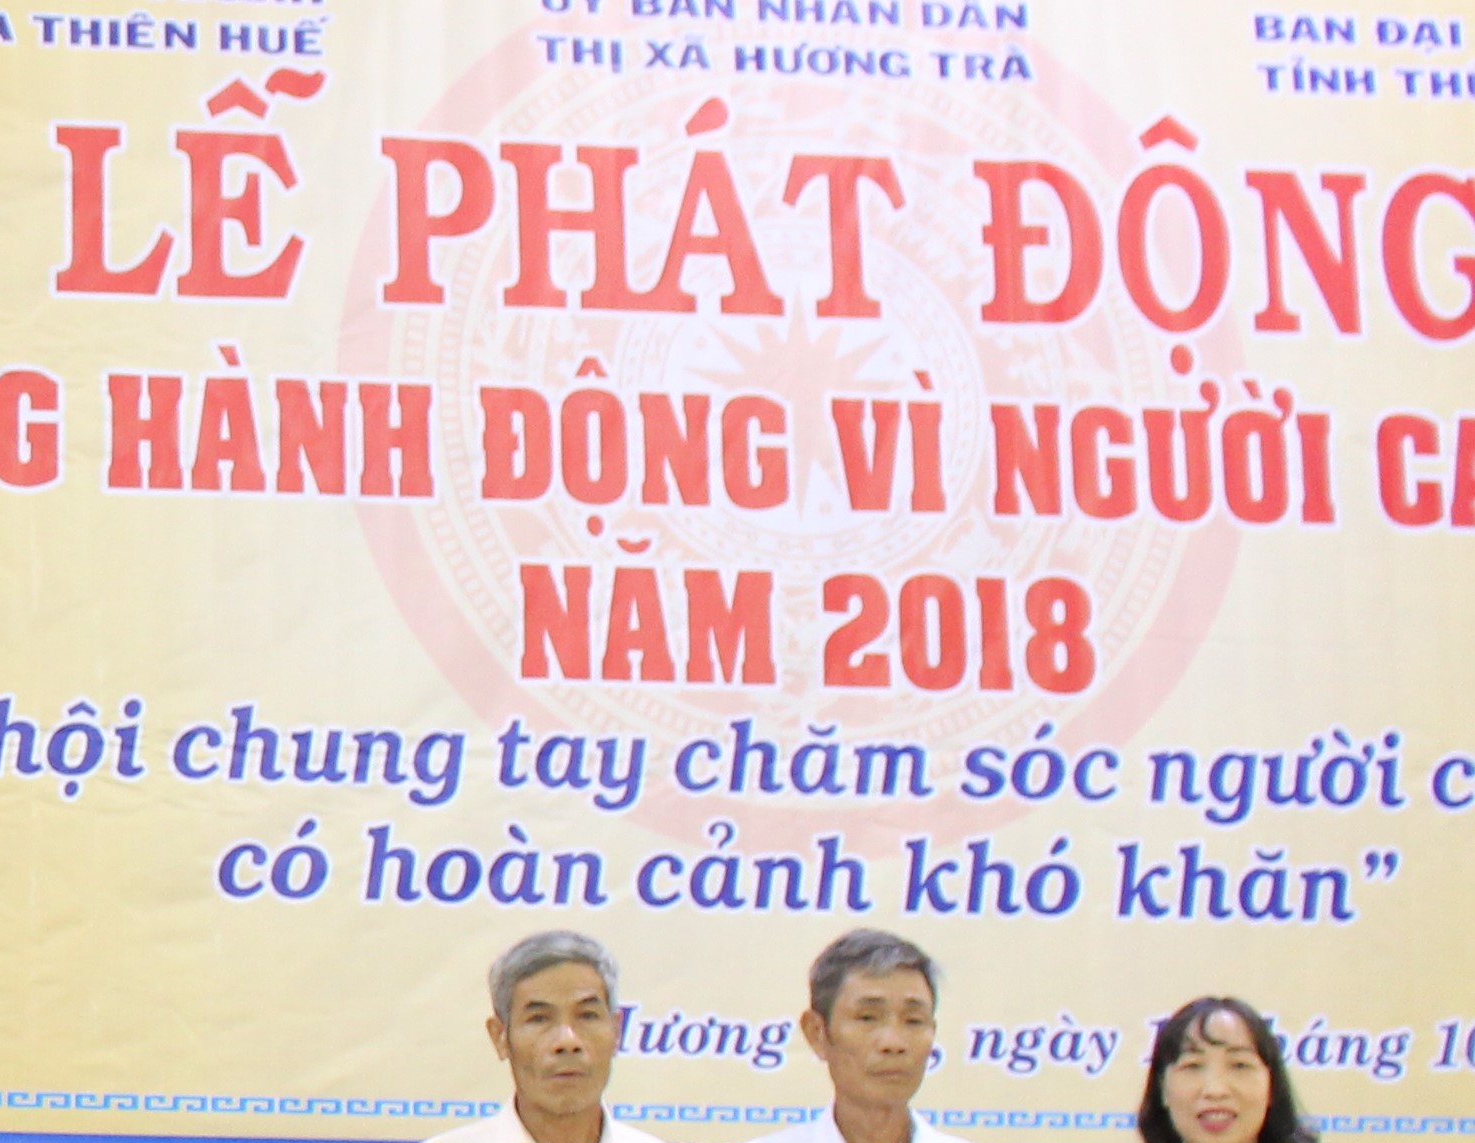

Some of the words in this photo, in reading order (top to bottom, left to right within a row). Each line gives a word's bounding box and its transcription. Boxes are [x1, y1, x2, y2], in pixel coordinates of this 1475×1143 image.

[32, 11, 196, 49] THIÊN
[219, 16, 328, 55] HUẾ
[536, 35, 621, 73] THỊ
[646, 34, 710, 69] XÃ
[733, 42, 911, 77] HƯƠNG
[930, 45, 1032, 80] TRÀ
[1254, 15, 1355, 43] BAN
[1375, 19, 1461, 53] ĐẠI
[1257, 56, 1376, 94] TỈNH
[56, 67, 325, 299] LỄ
[382, 98, 905, 318] PHÁT
[974, 114, 1475, 376] ĐỘNG
[106, 344, 435, 498] HÀNH
[480, 356, 789, 537] ĐỘNG
[831, 370, 945, 513] VÌ
[990, 378, 1337, 524] NGƯỜI
[518, 537, 775, 685] NĂM
[820, 573, 1095, 695] 2018
[172, 704, 465, 808] chung
[496, 719, 646, 812] tay
[673, 717, 933, 799] chăm
[958, 721, 1119, 802] sóc
[1147, 729, 1405, 826] người
[218, 817, 329, 900] có
[364, 822, 608, 907] hoàn
[635, 821, 872, 912] cảnh
[904, 836, 1081, 917] khó
[970, 1013, 1118, 1073] ngày
[1264, 1016, 1410, 1078] áng
